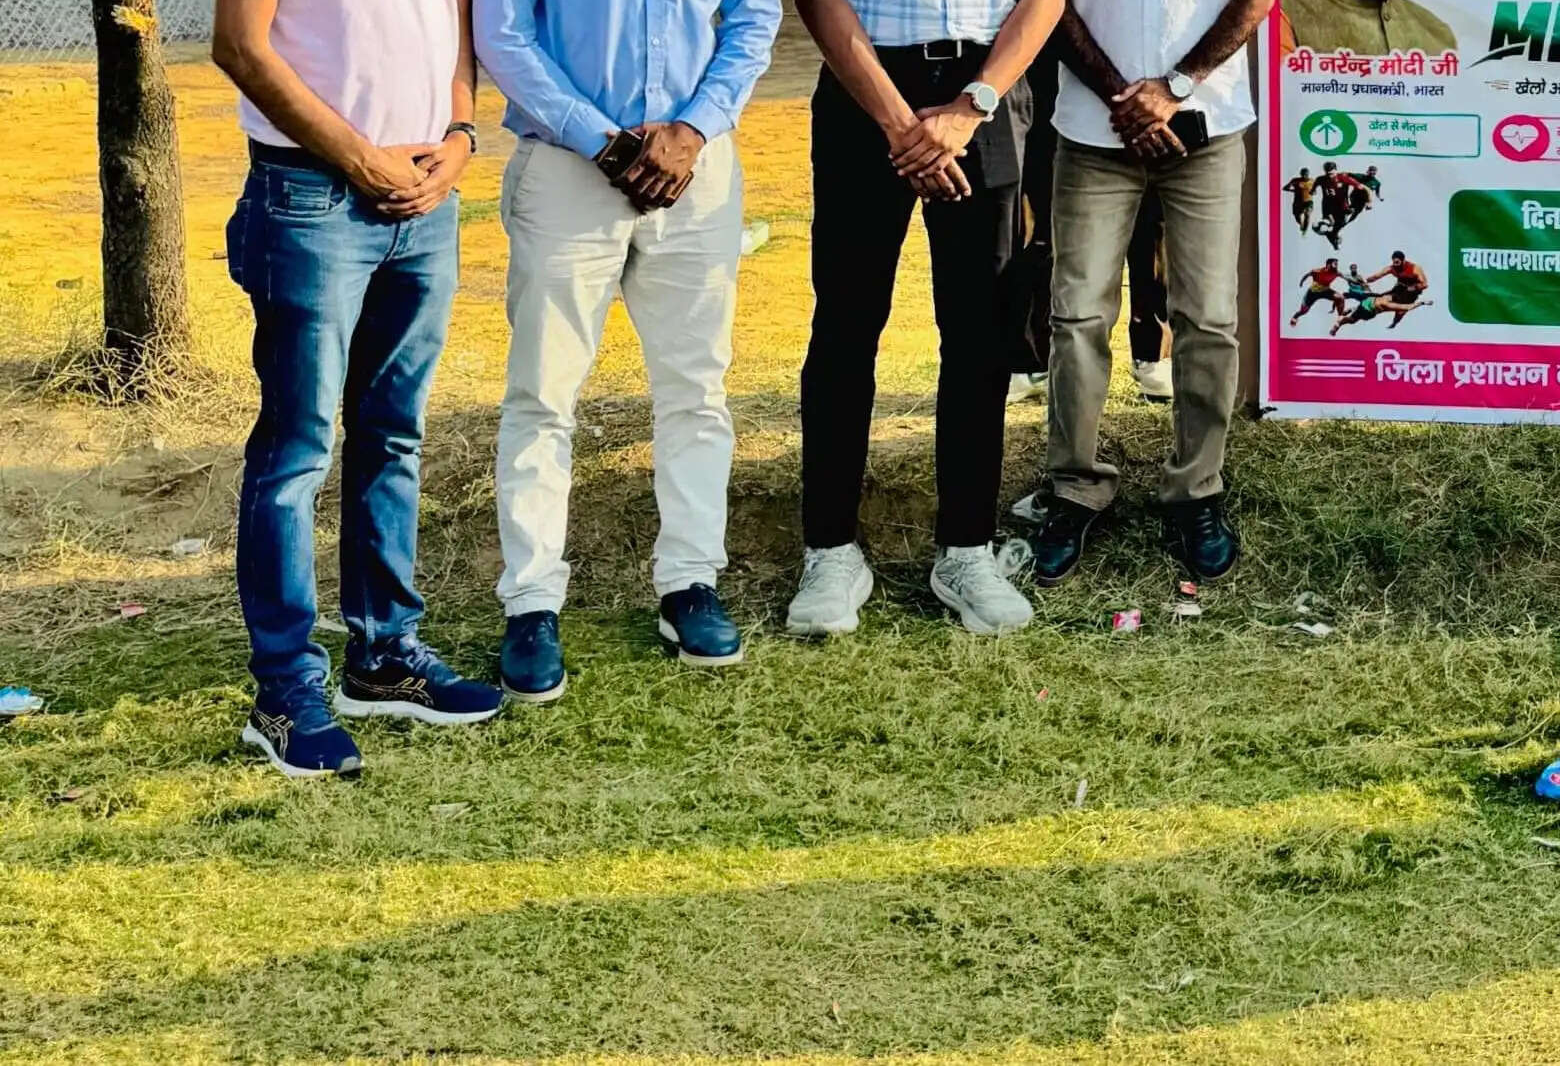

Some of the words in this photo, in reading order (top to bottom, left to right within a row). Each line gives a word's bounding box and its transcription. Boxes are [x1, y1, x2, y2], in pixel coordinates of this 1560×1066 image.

[1287, 49, 1313, 73] श्री
[1379, 51, 1424, 76] मोदी
[1430, 52, 1460, 76] जी
[1301, 79, 1348, 93] माननीय
[1414, 85, 1445, 96] भारत
[1515, 78, 1546, 95] खेलो
[1375, 348, 1446, 383] जिला
[1452, 360, 1551, 388] प्रशासन
